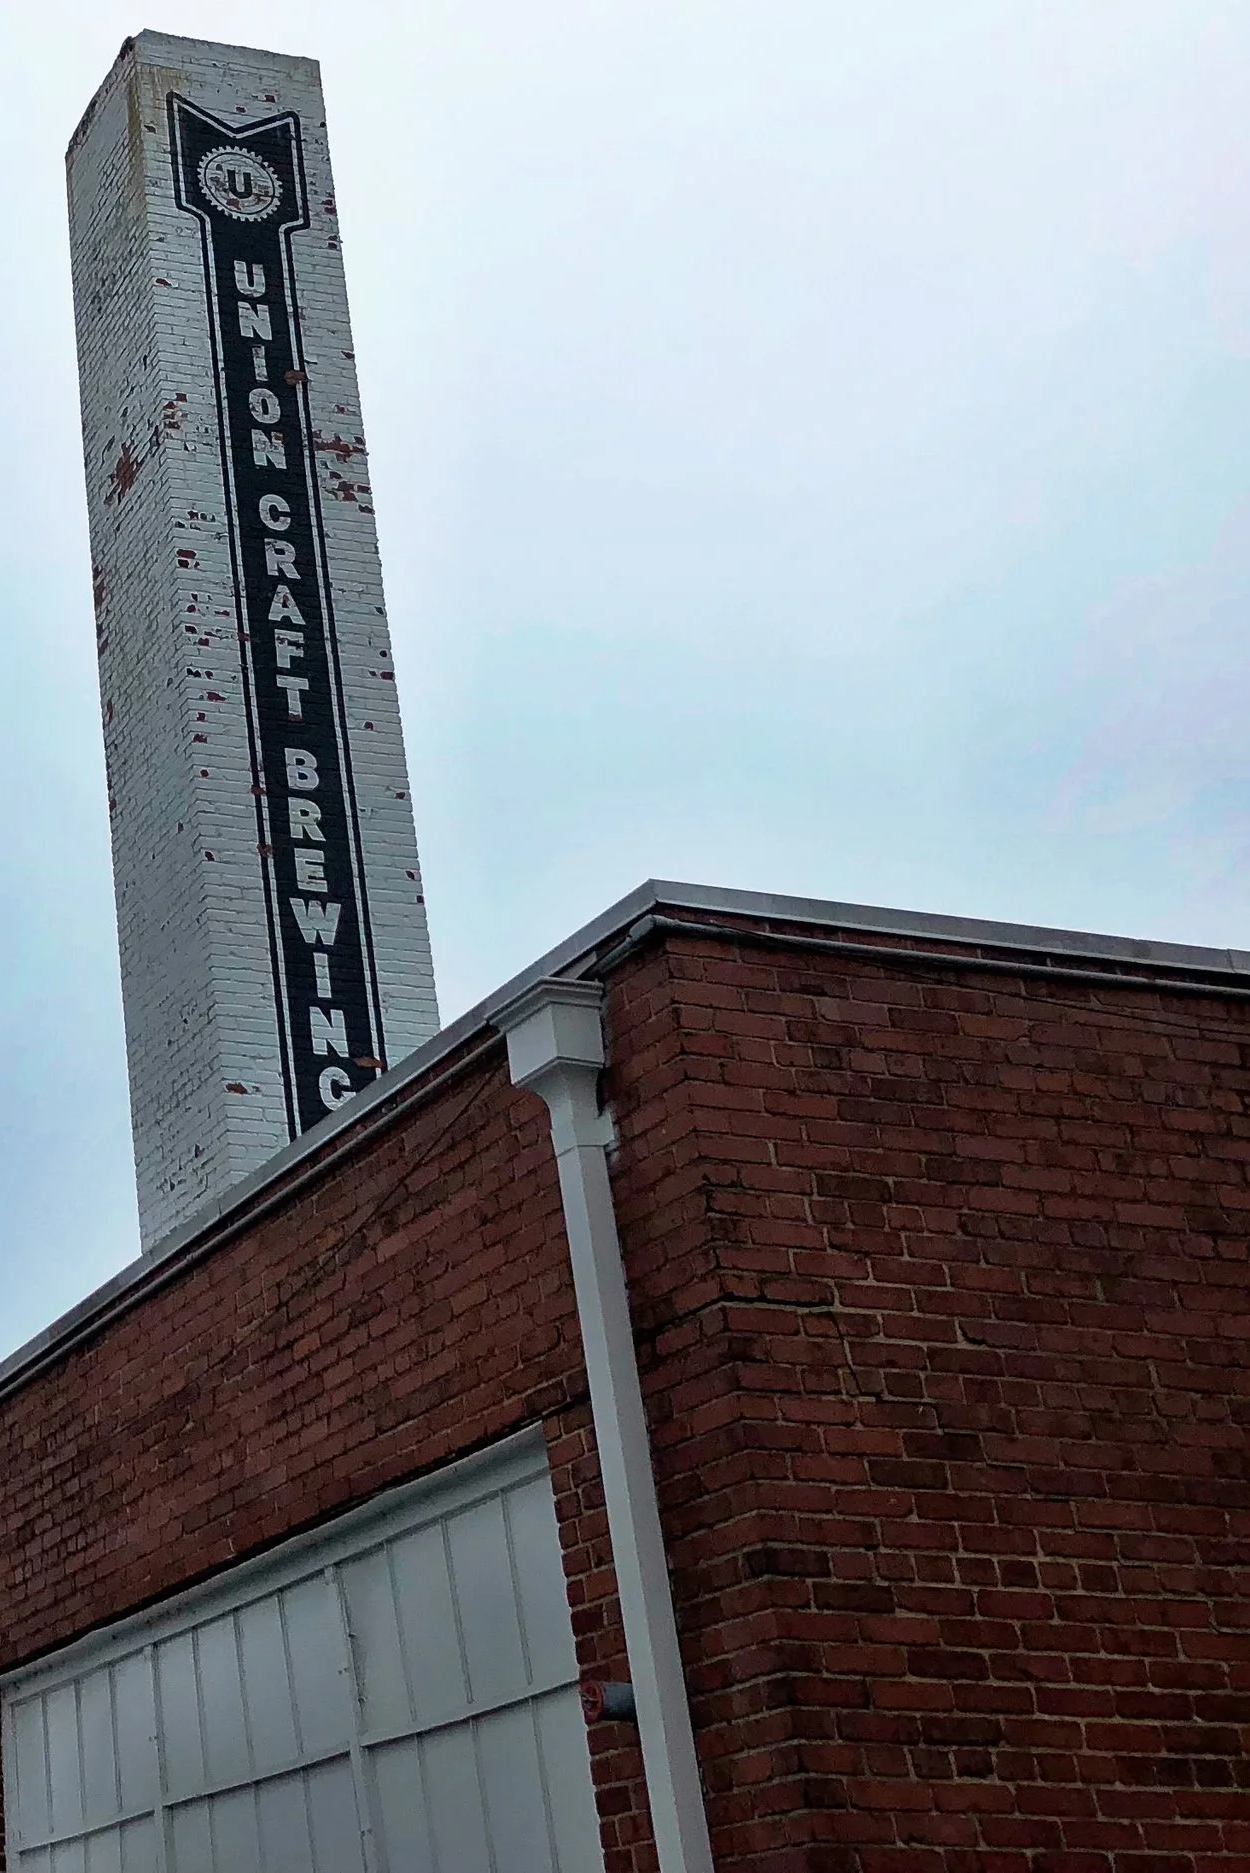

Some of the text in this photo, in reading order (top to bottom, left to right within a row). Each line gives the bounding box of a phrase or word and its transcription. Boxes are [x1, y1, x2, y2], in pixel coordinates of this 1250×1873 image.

[226, 168, 253, 199] U
[233, 260, 287, 470] UNION
[258, 493, 310, 721] CRAFT
